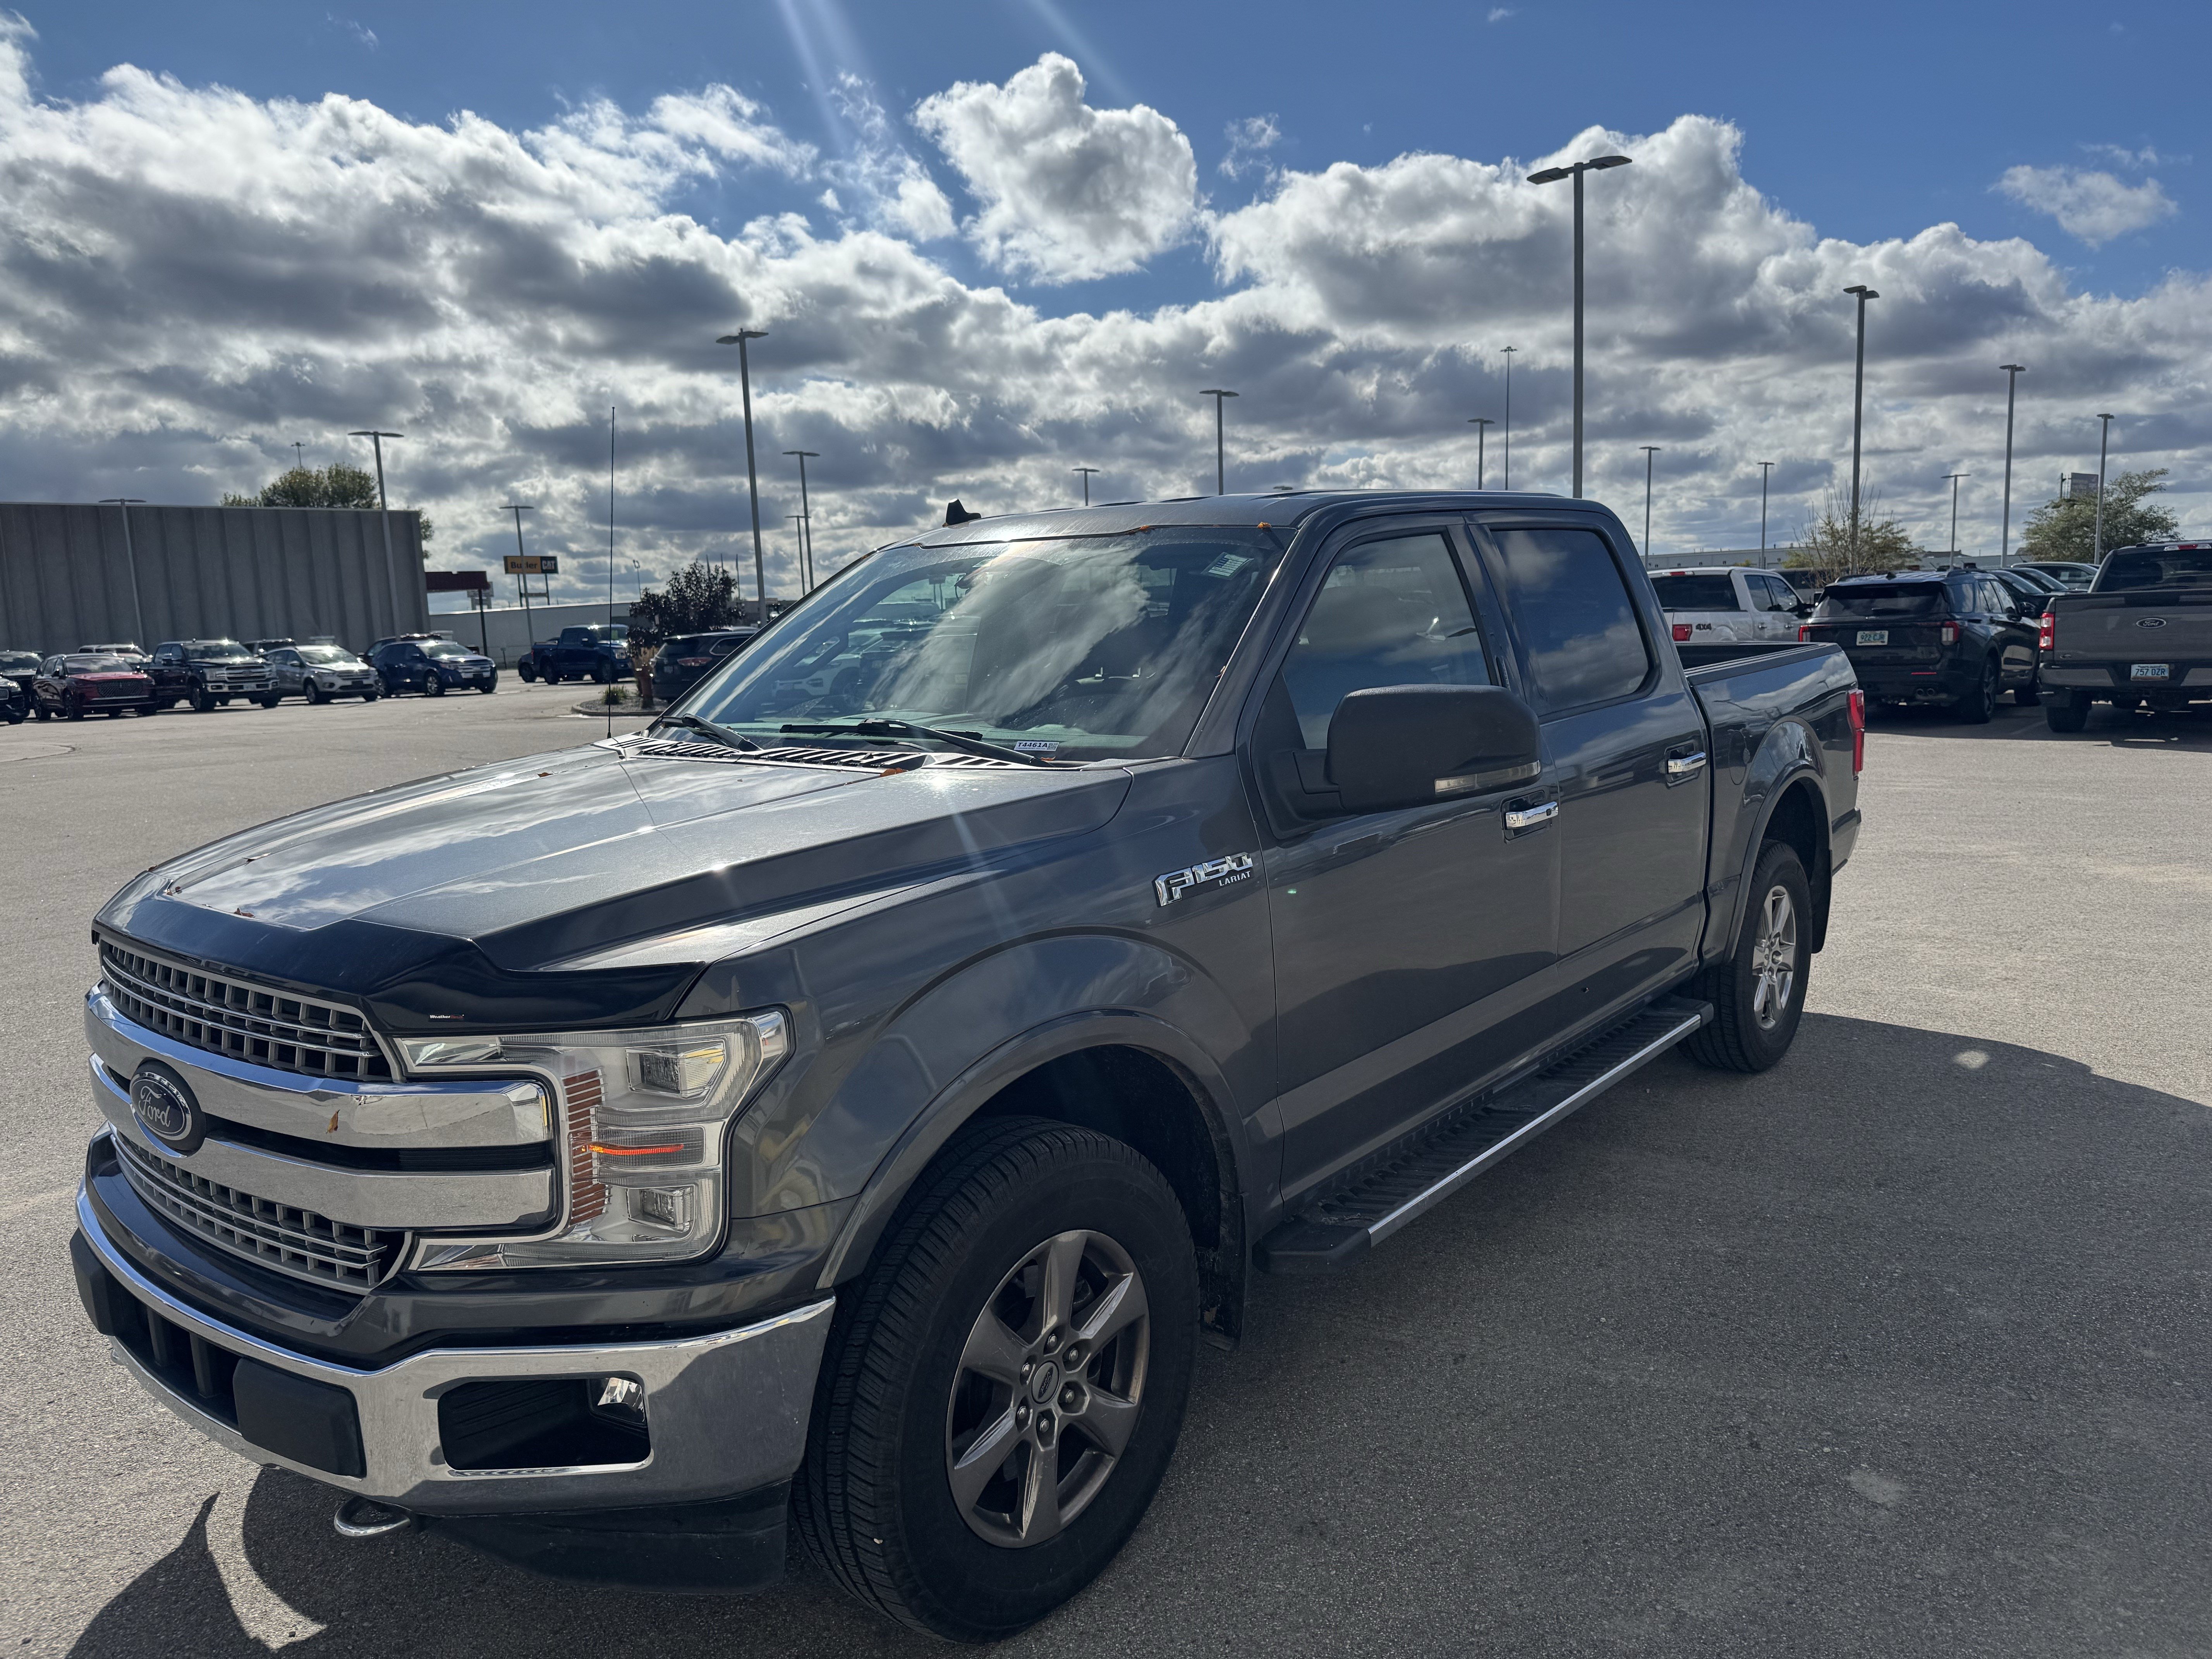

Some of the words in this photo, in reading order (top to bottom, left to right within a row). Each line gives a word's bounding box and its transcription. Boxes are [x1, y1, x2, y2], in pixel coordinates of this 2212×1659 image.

[542, 561, 555, 570] CAT
[1219, 871, 1251, 886] LARIAT
[138, 1085, 171, 1127] Ford
[1041, 1372, 1052, 1394] Ford
